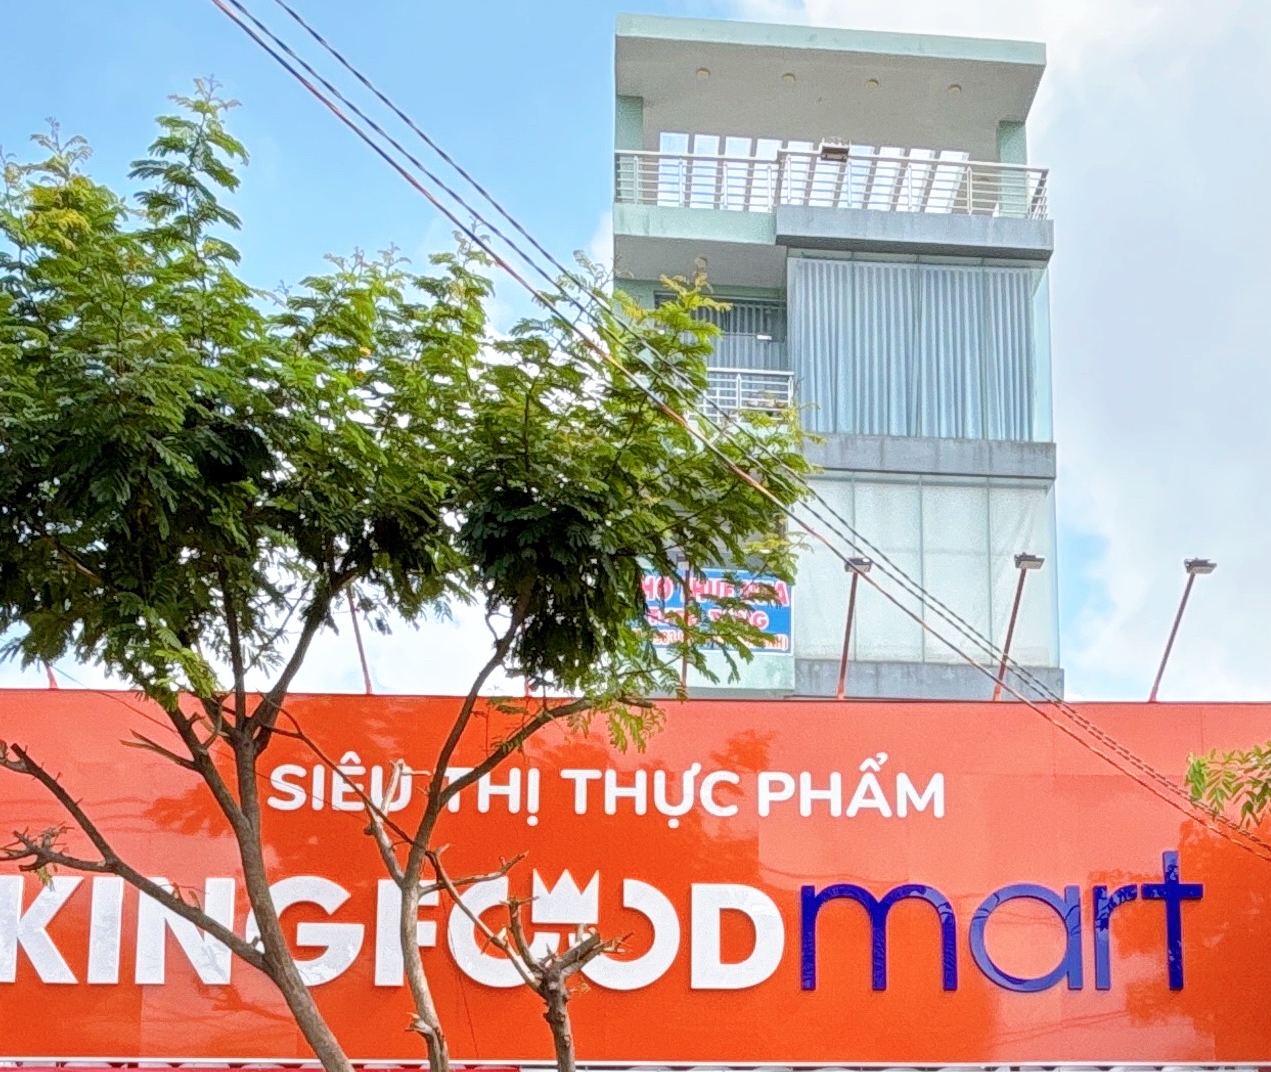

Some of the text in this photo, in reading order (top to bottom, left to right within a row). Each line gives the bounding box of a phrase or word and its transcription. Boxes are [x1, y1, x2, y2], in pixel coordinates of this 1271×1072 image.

[267, 751, 945, 828] SIÊU THỊ THỰC PHẨM
